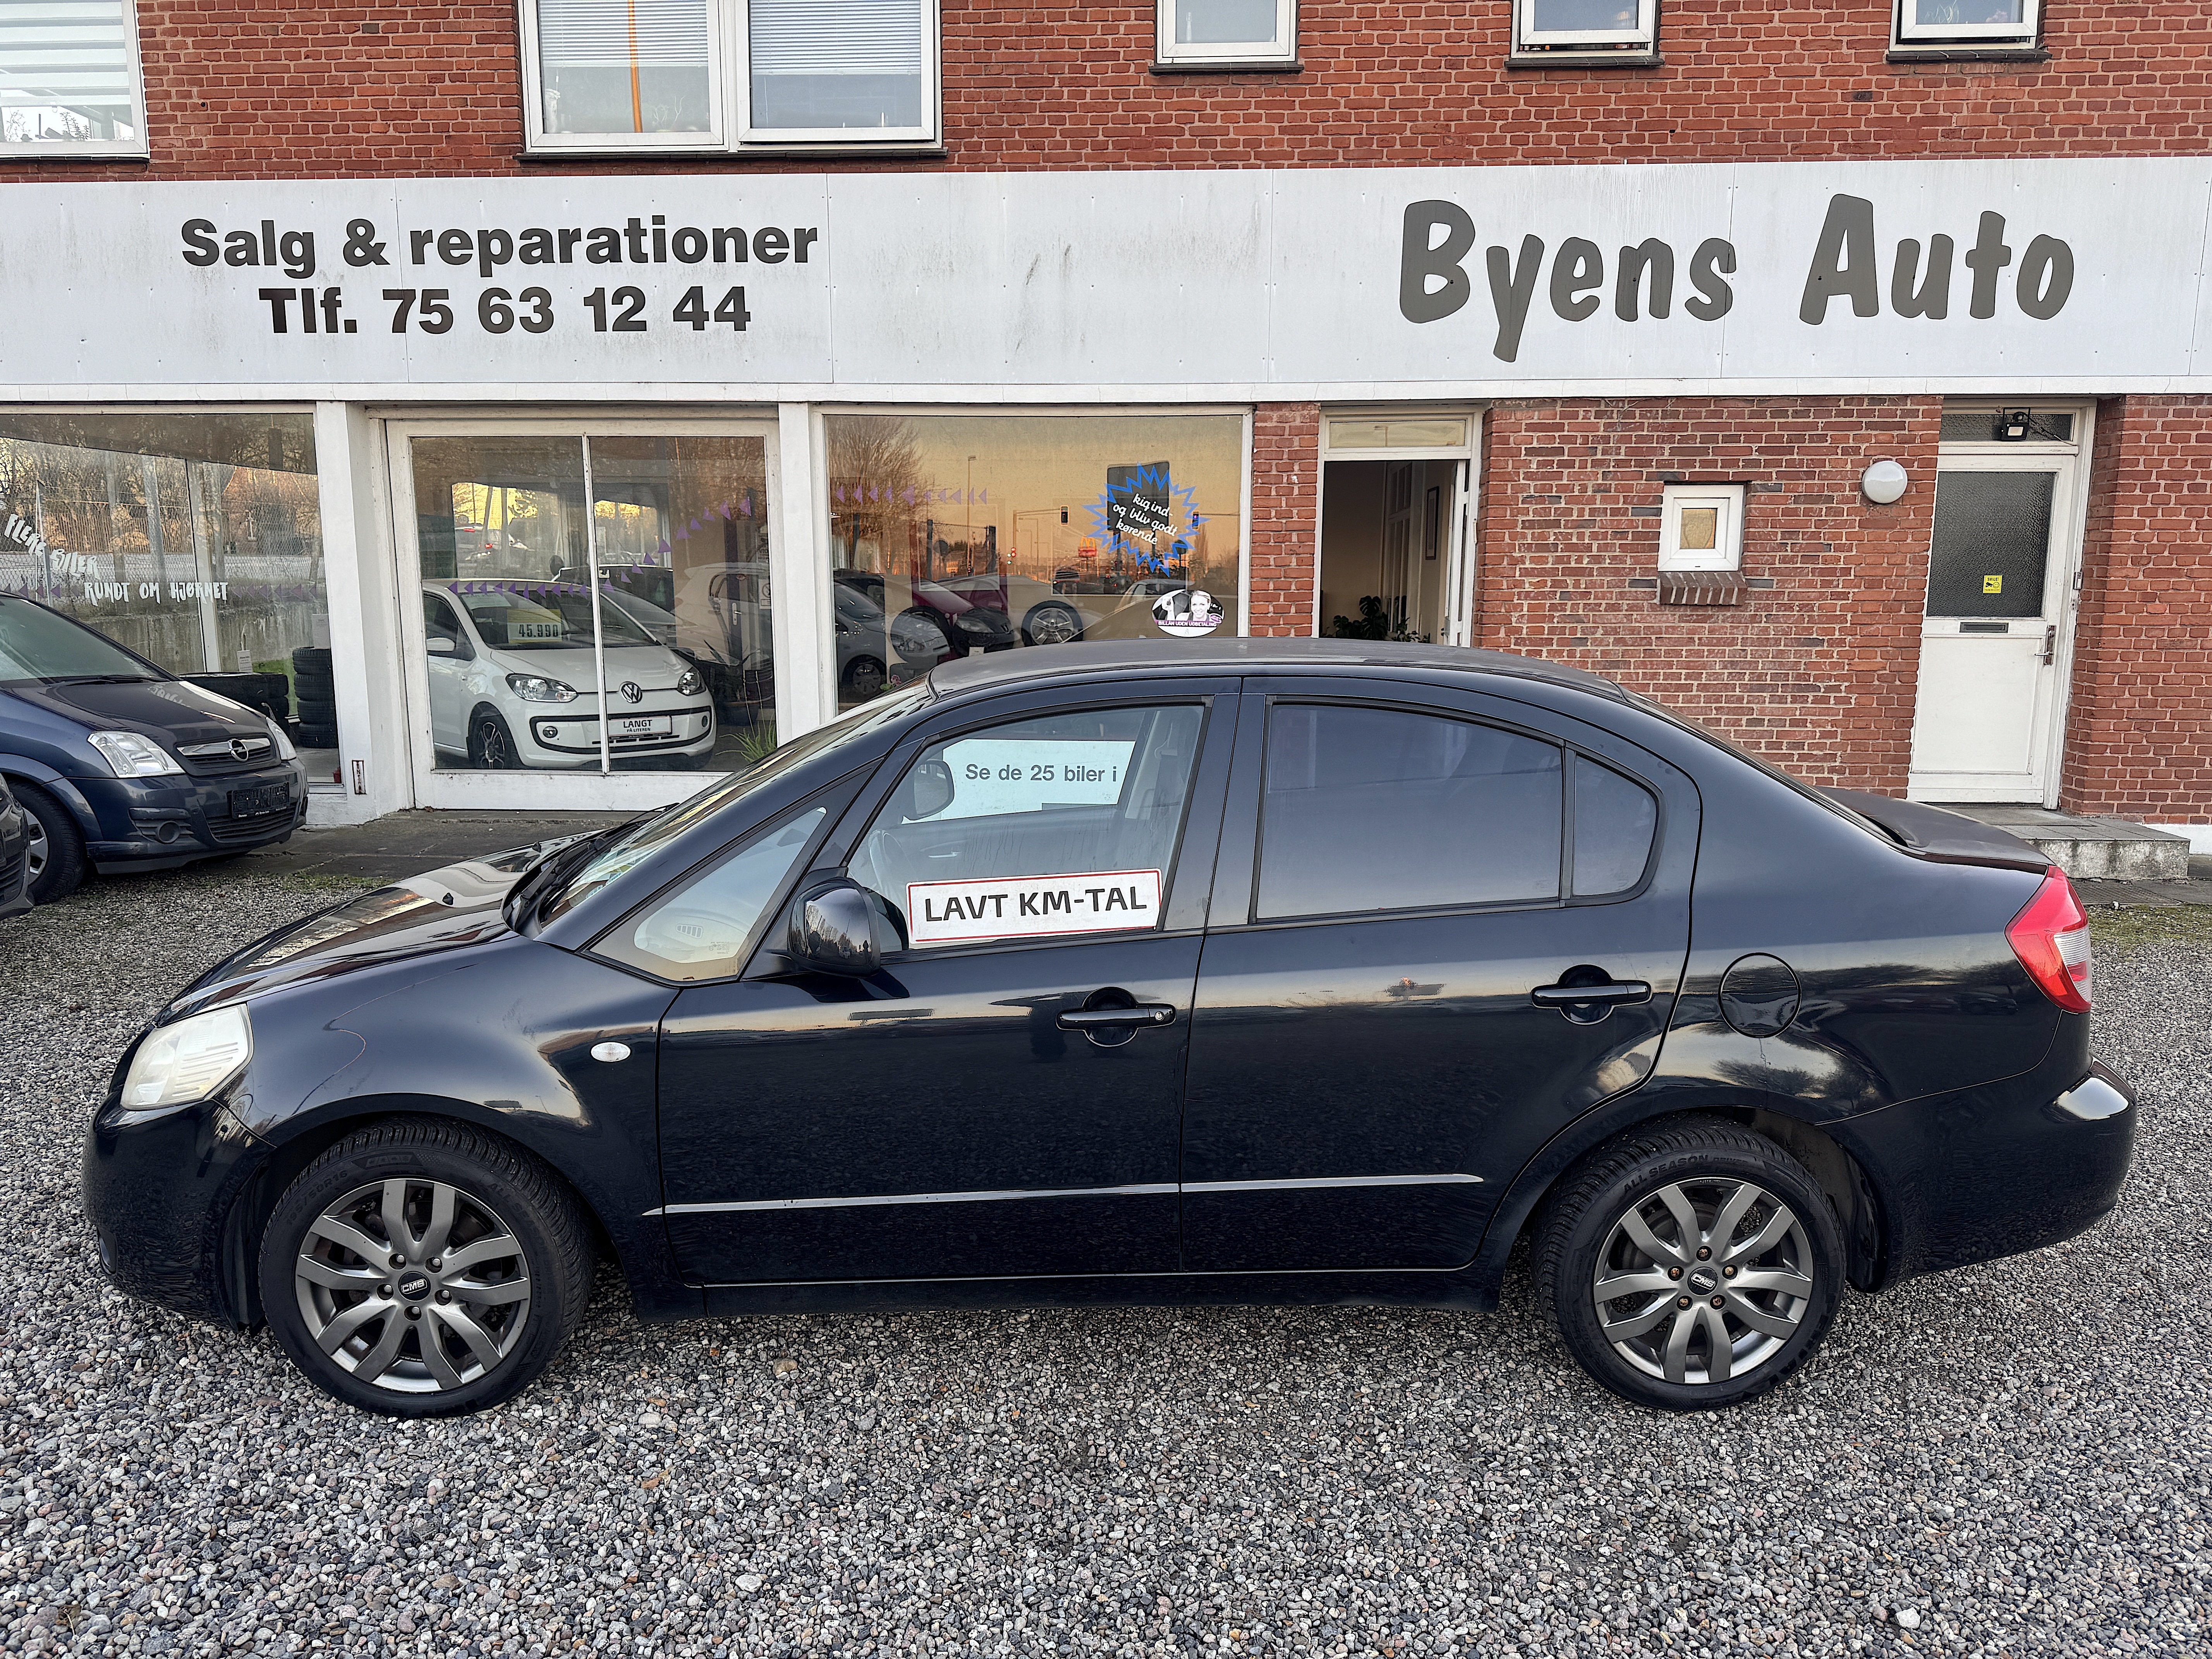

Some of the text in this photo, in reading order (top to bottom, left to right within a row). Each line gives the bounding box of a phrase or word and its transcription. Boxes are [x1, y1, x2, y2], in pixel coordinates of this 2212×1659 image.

[181, 215, 817, 279] Salg & reparationer
[1400, 194, 2074, 362] Byens Auto
[258, 286, 751, 334] Tlf. 75 63 12 44
[1133, 493, 1151, 511] kig
[1113, 504, 1178, 537] og bliv godt
[1115, 519, 1158, 545] kørende
[4, 514, 101, 580] FLERE BILER
[84, 582, 229, 607] RUNDT OM HJØRNET
[519, 624, 559, 637] 45.990
[623, 720, 653, 728] LANGT
[965, 764, 1117, 782] Se de 25 biler i
[925, 886, 1147, 922] LAVT KM-TAL
[1623, 1175, 1647, 1192] ALL
[1649, 1154, 1708, 1177] SEASON
[402, 1279, 425, 1292] CMS
[1692, 1274, 1715, 1287] CMS
